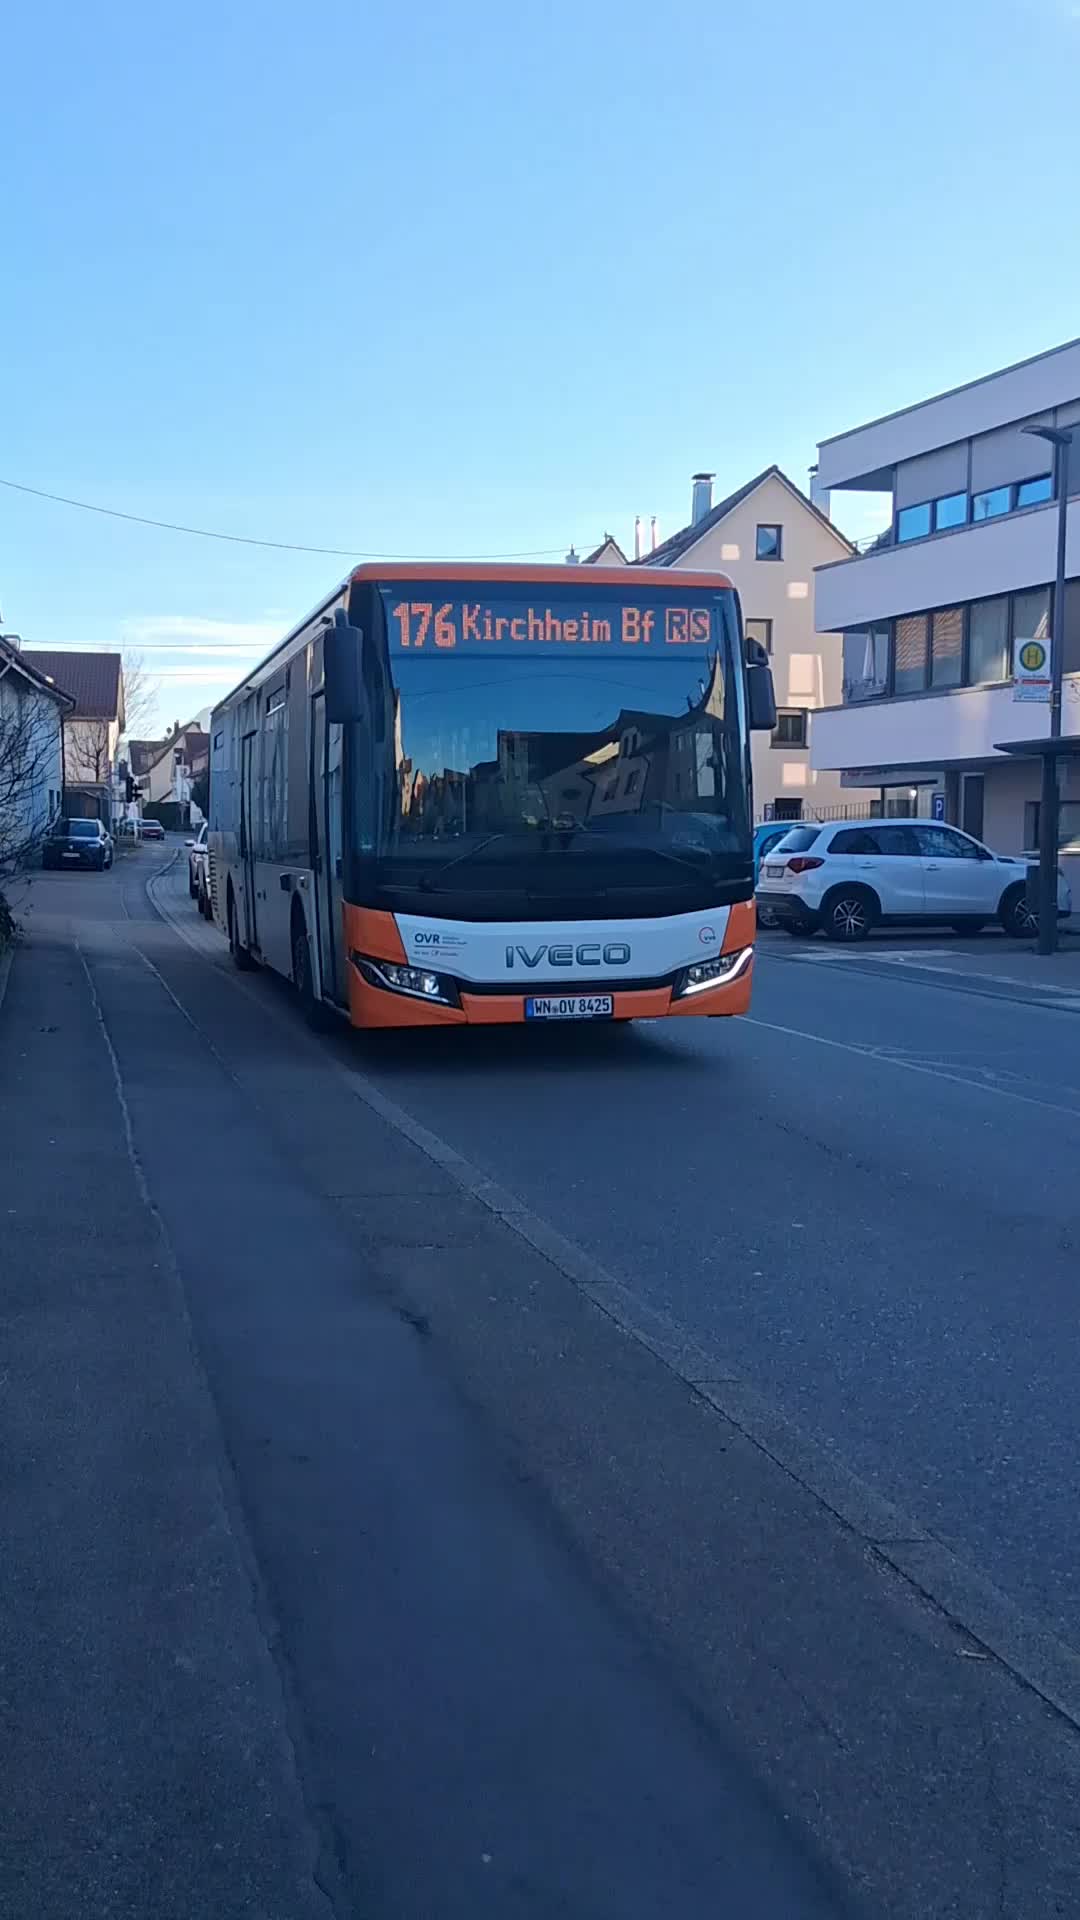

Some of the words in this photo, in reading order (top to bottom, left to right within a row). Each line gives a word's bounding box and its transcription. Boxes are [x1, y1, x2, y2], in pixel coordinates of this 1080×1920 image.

[393, 603, 456, 647] 176
[462, 604, 611, 642] Kirchheim
[621, 607, 655, 642] Bf
[1027, 647, 1039, 665] H
[935, 800, 943, 819] P
[414, 932, 440, 944] OVR
[505, 943, 631, 968] IVECO
[534, 999, 551, 1014] WN
[559, 999, 576, 1014] OV
[578, 997, 610, 1013] 8425
